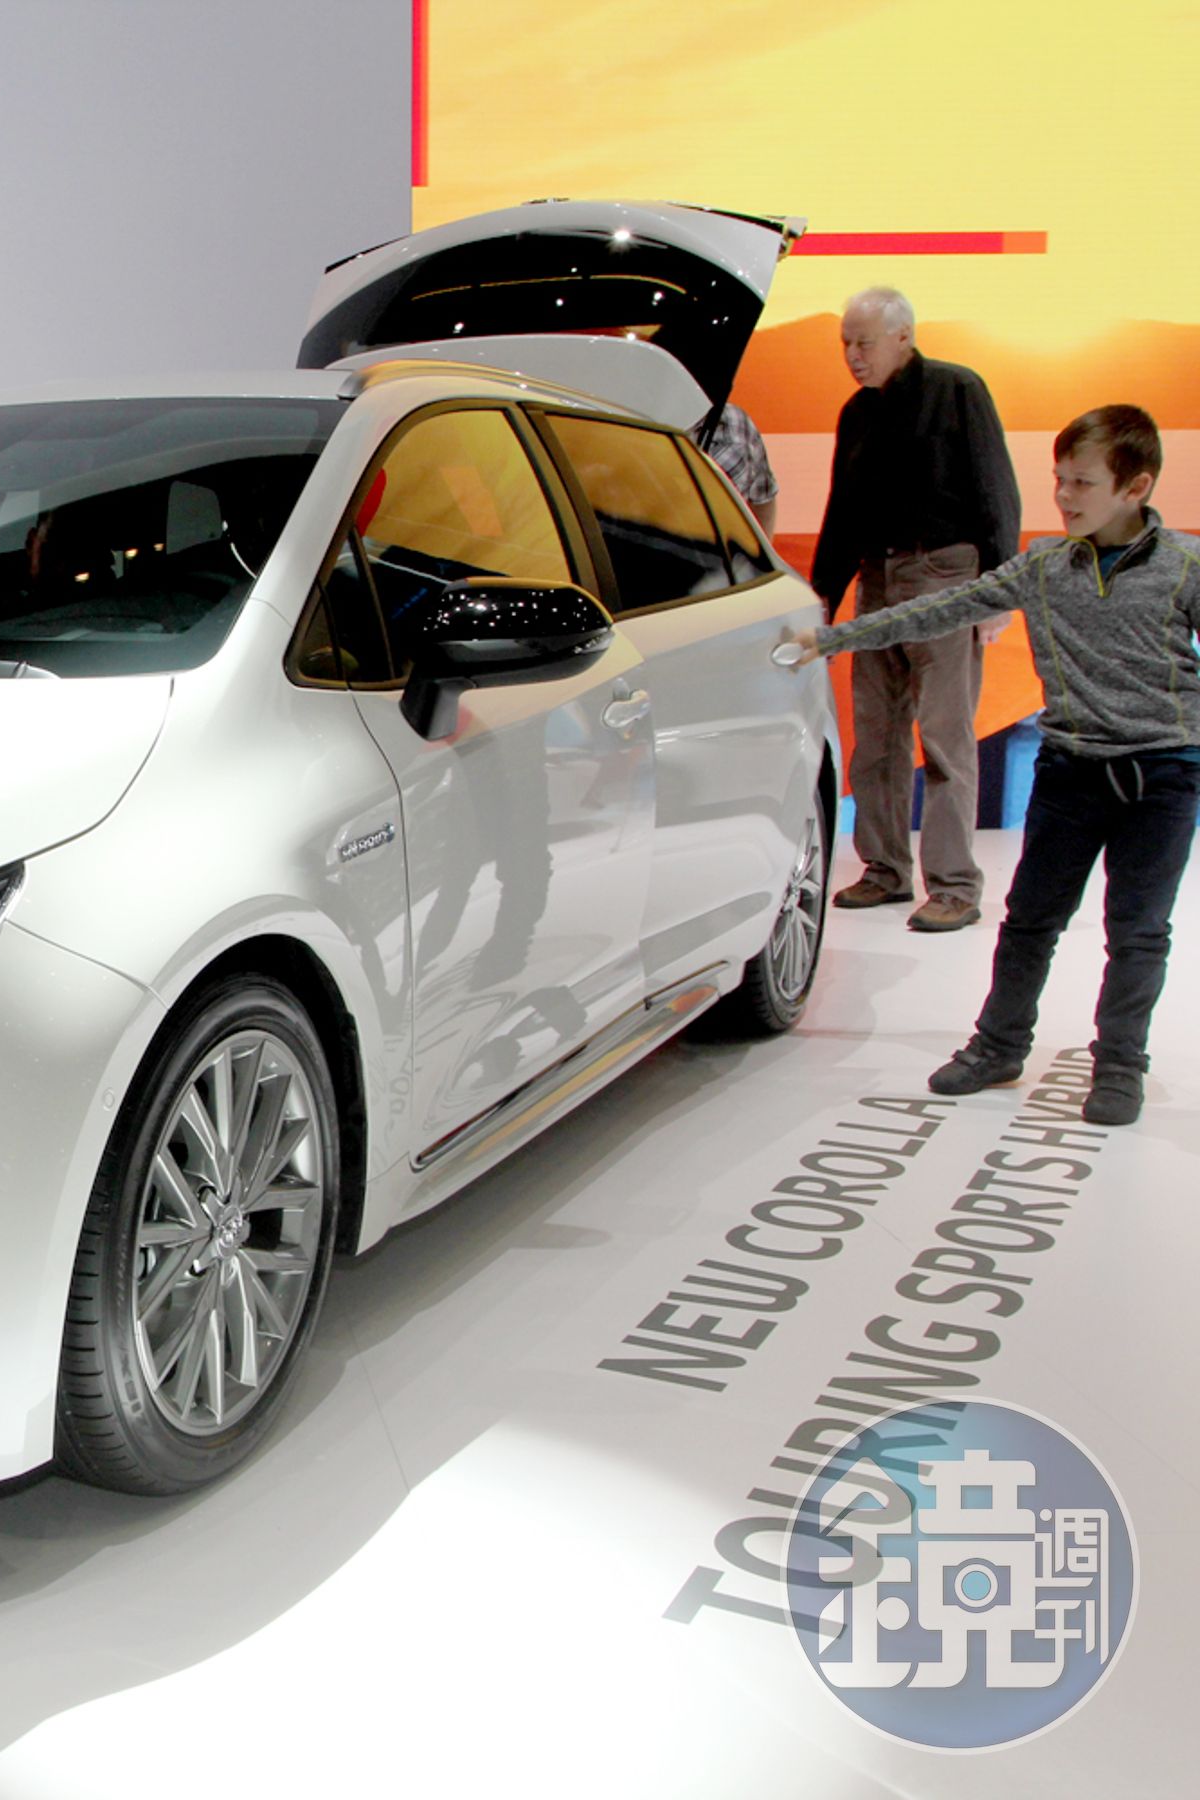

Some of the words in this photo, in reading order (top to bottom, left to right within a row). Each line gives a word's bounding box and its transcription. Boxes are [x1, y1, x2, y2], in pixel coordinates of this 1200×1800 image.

[596, 1259, 809, 1392] NEW
[725, 1097, 958, 1260] COROLLA
[662, 1314, 1001, 1640] TOURING
[895, 1150, 1093, 1318] SPORTS
